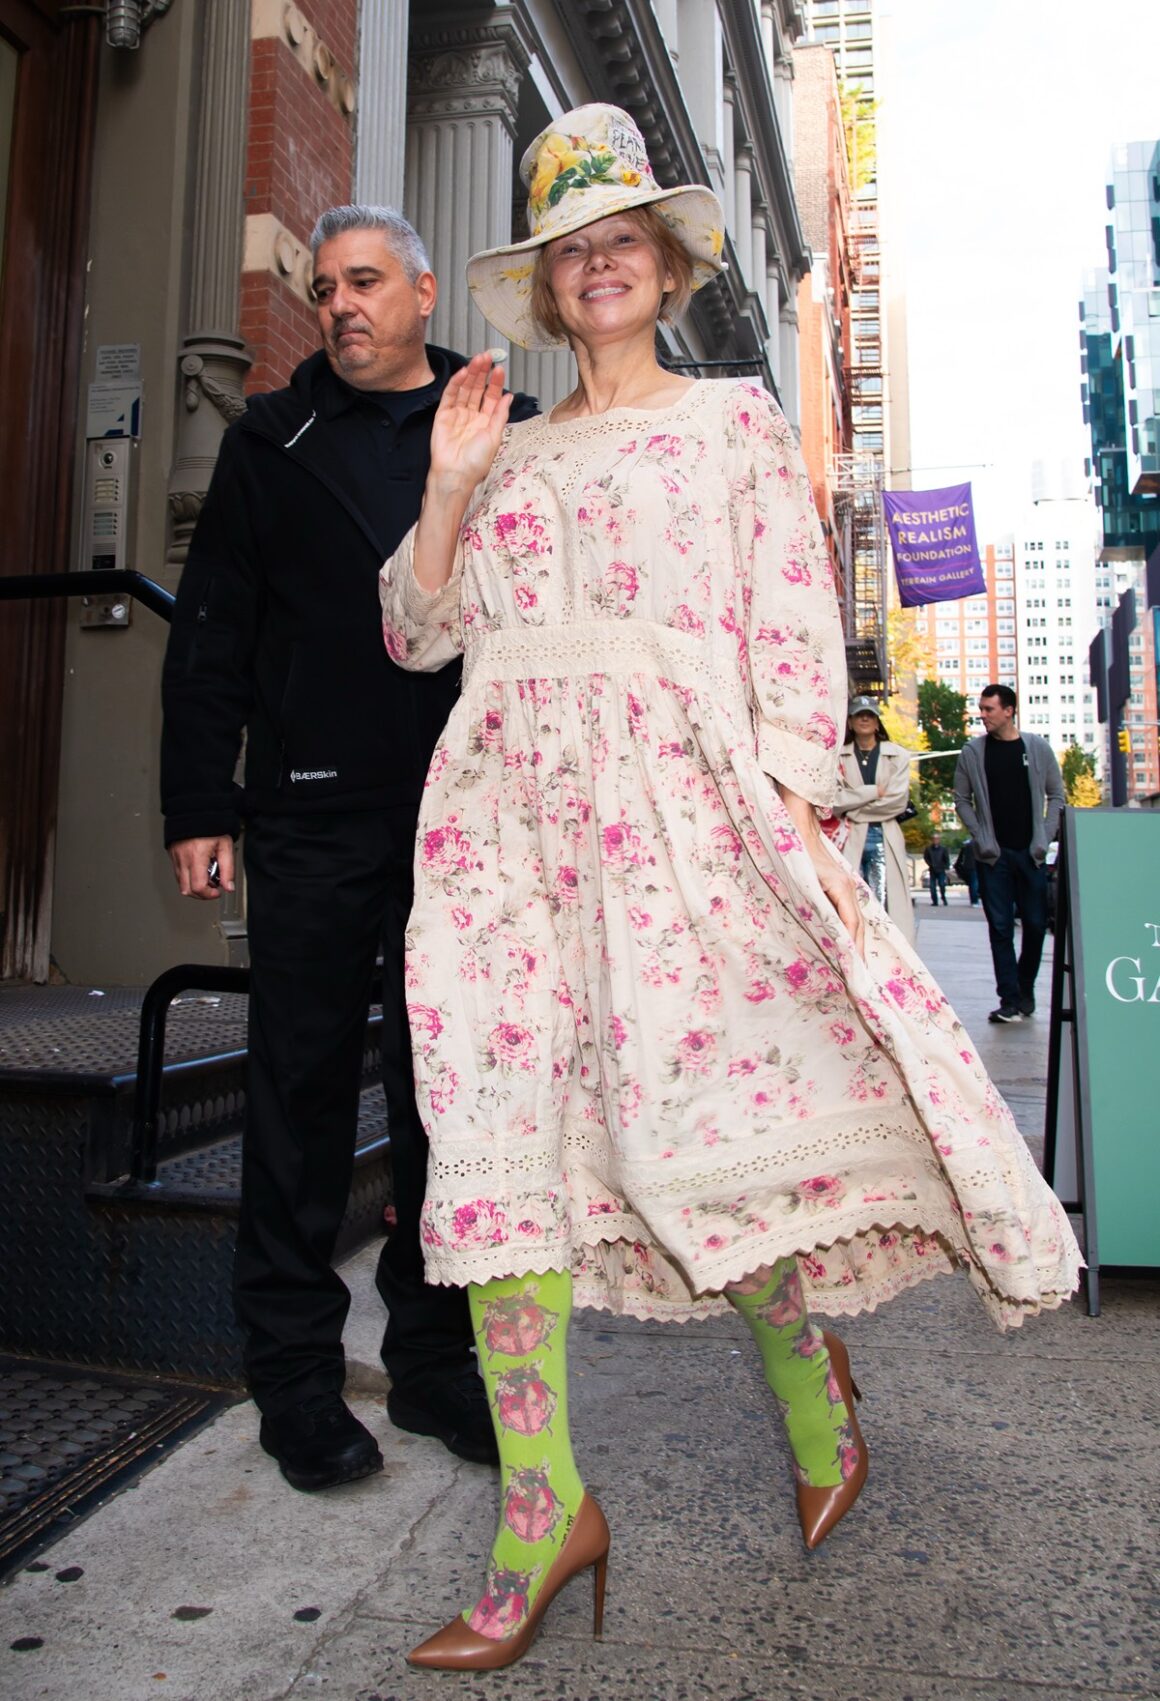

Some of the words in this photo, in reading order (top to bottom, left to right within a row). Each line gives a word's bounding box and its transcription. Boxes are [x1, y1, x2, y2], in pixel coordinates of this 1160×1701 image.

[892, 503, 970, 525] AESTHETIC
[897, 525, 967, 545] REALISM
[896, 544, 972, 563] FOUNDATION
[939, 567, 975, 582] GALLERY
